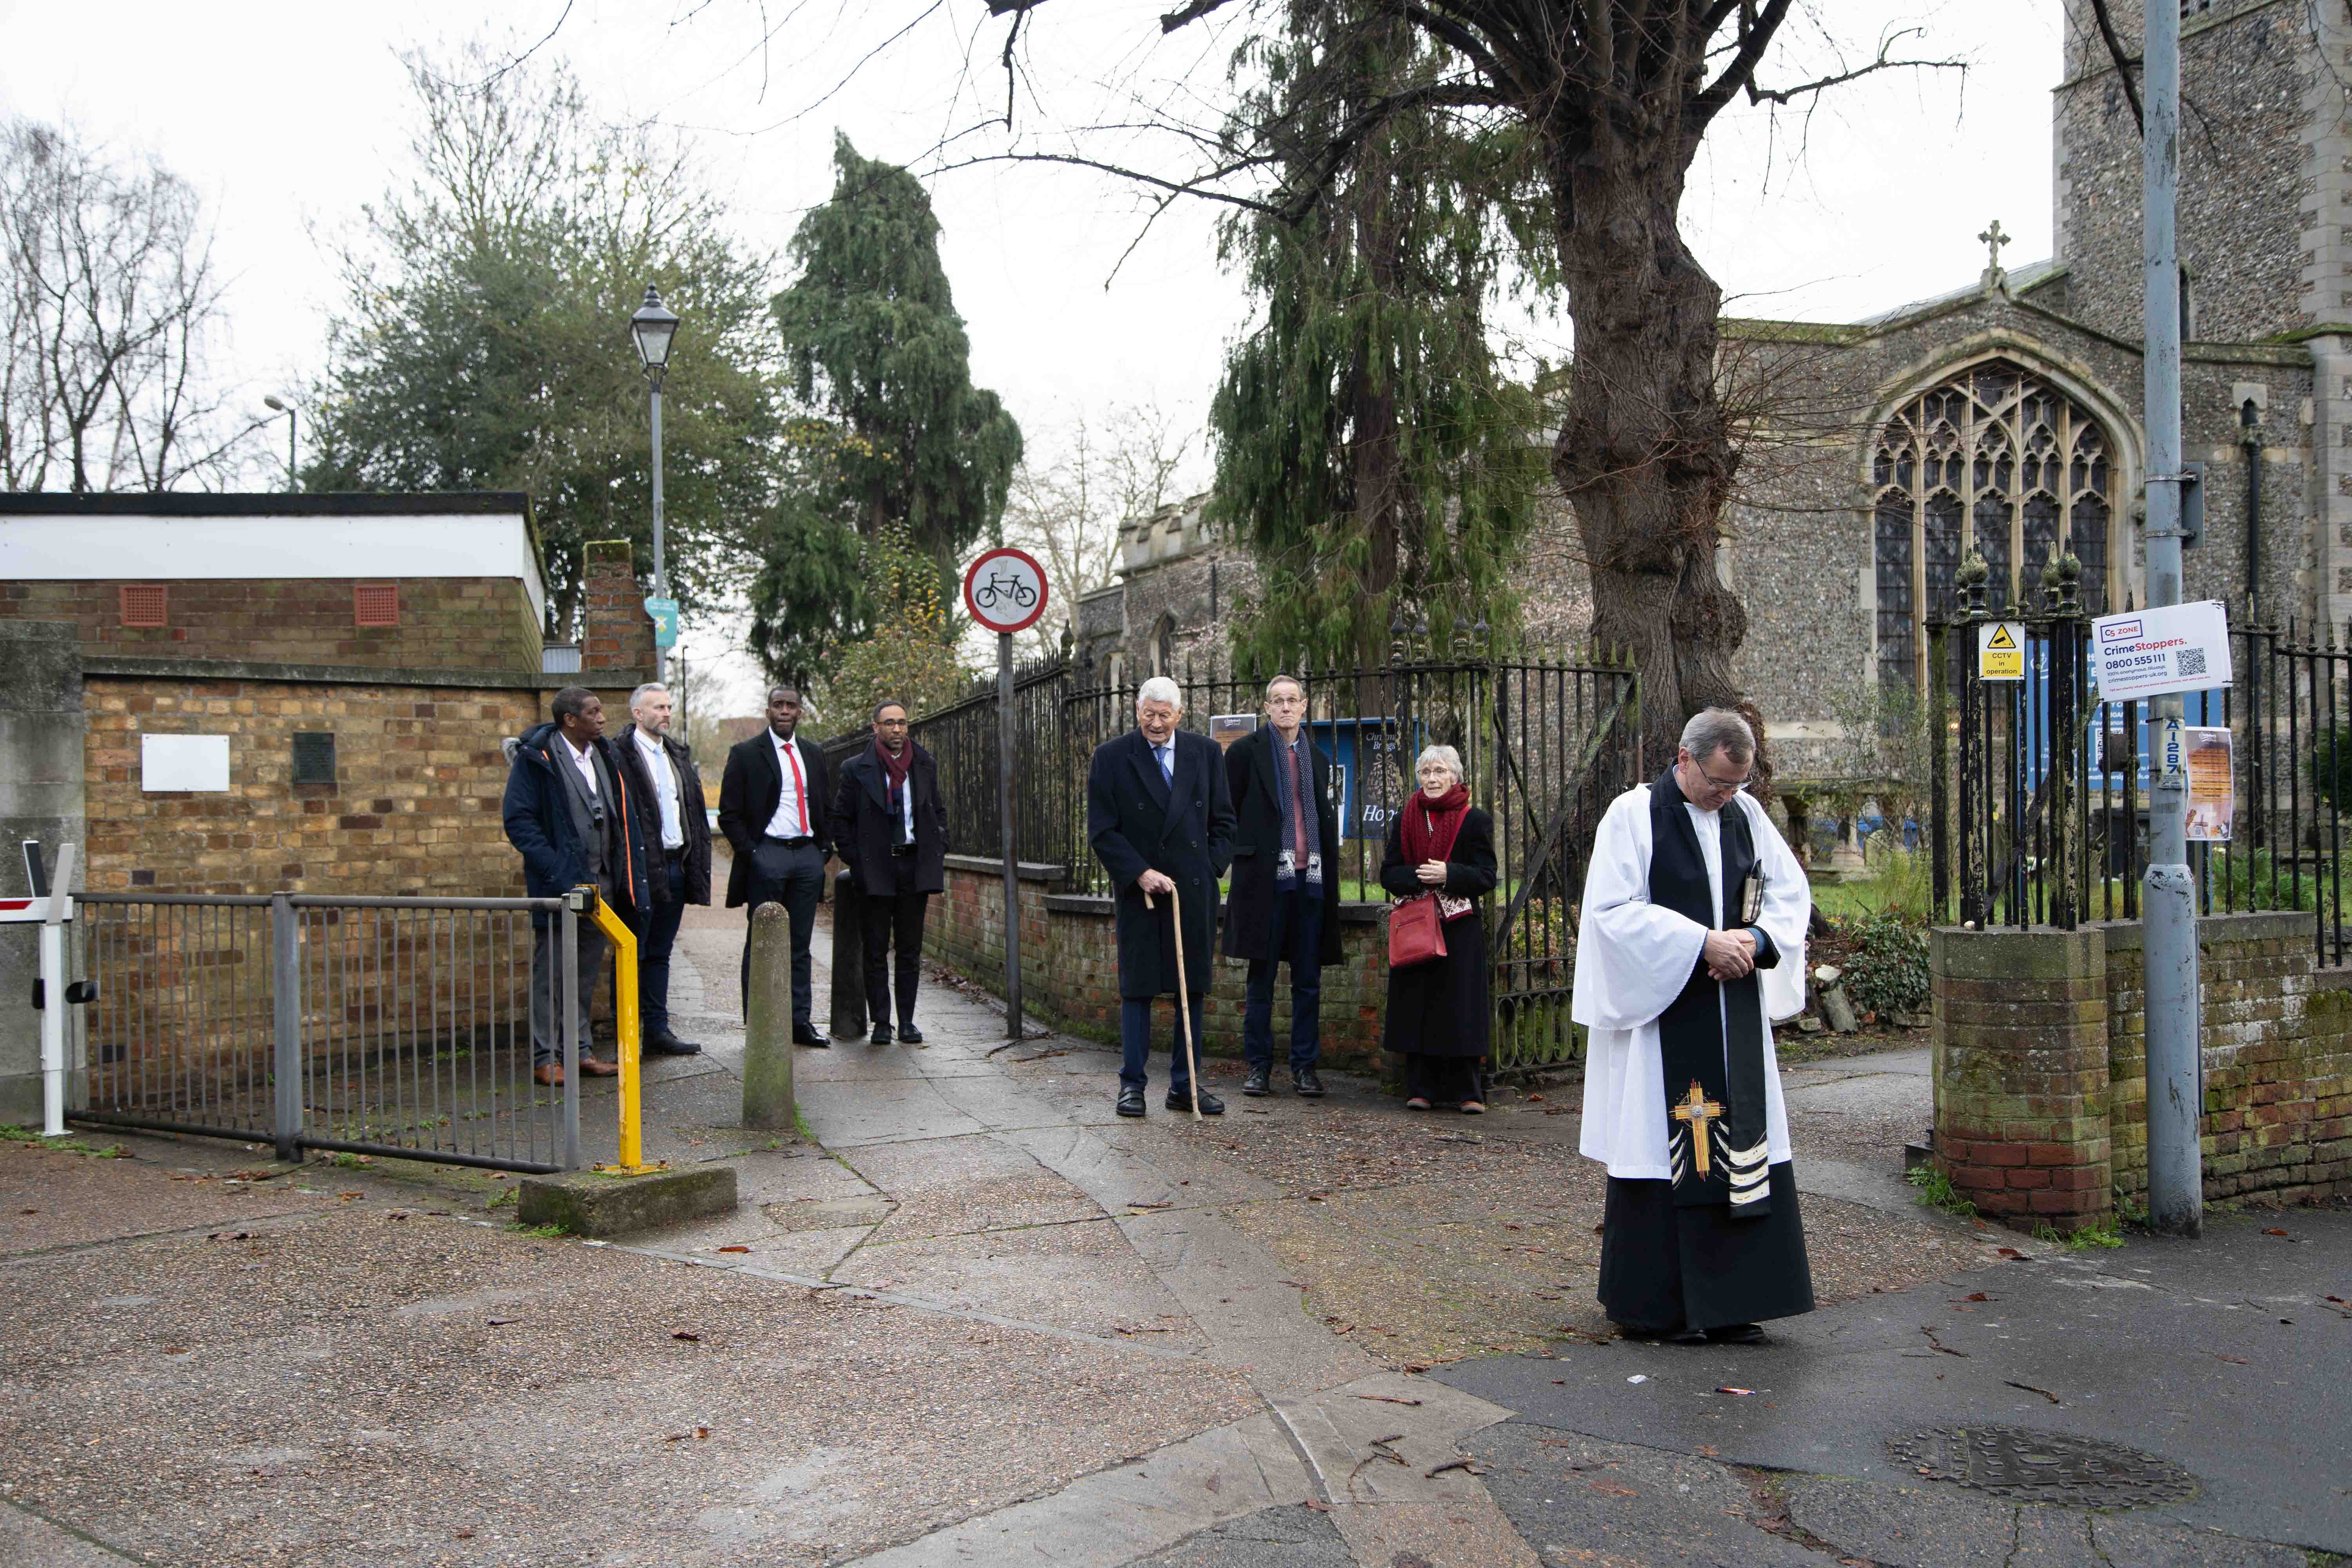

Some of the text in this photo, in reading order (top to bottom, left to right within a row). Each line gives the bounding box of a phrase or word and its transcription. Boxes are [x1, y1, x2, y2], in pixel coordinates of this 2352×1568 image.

[2104, 637, 2187, 656] CrimeStoppers.
[2105, 659, 2132, 670] 0800
[2108, 671, 2167, 684] crimestoppers-uk.org
